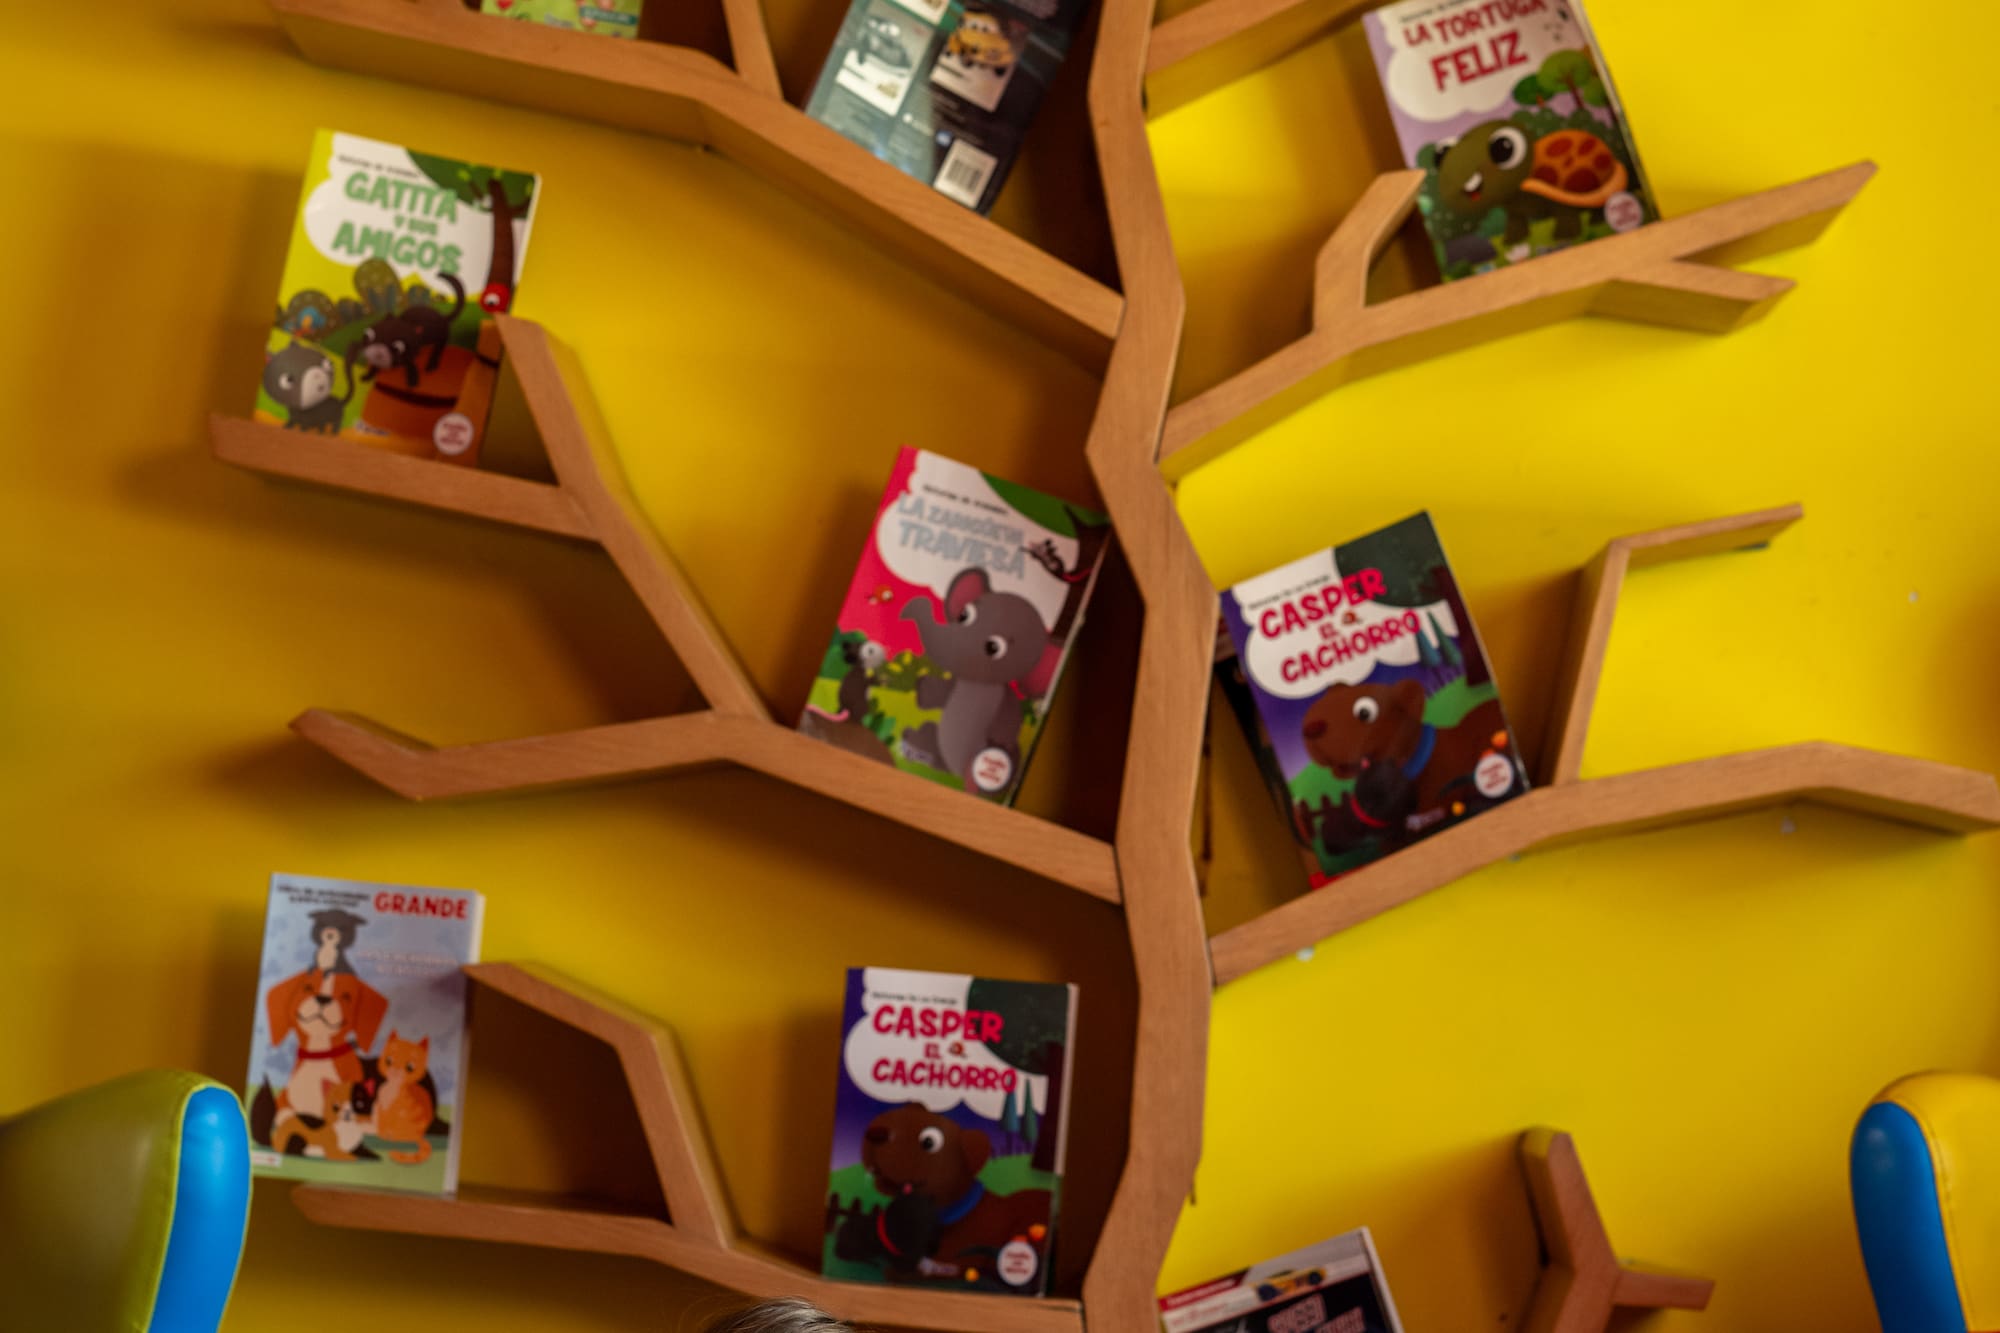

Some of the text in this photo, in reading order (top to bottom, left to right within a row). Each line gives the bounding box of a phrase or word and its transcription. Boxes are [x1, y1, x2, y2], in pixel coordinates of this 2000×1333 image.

[1403, 22, 1432, 47] LA
[1430, 29, 1529, 92] FELIZ
[344, 171, 457, 224] GATITA
[331, 221, 463, 275] AMIGOS
[1260, 568, 1387, 638] CASPER
[1281, 609, 1421, 684] CACHORRO
[1319, 623, 1338, 640] EL
[373, 891, 468, 920] GRANDE
[873, 1004, 1005, 1043] CASPER
[924, 1043, 941, 1059] EL
[872, 1058, 1018, 1093] CACHORRO
